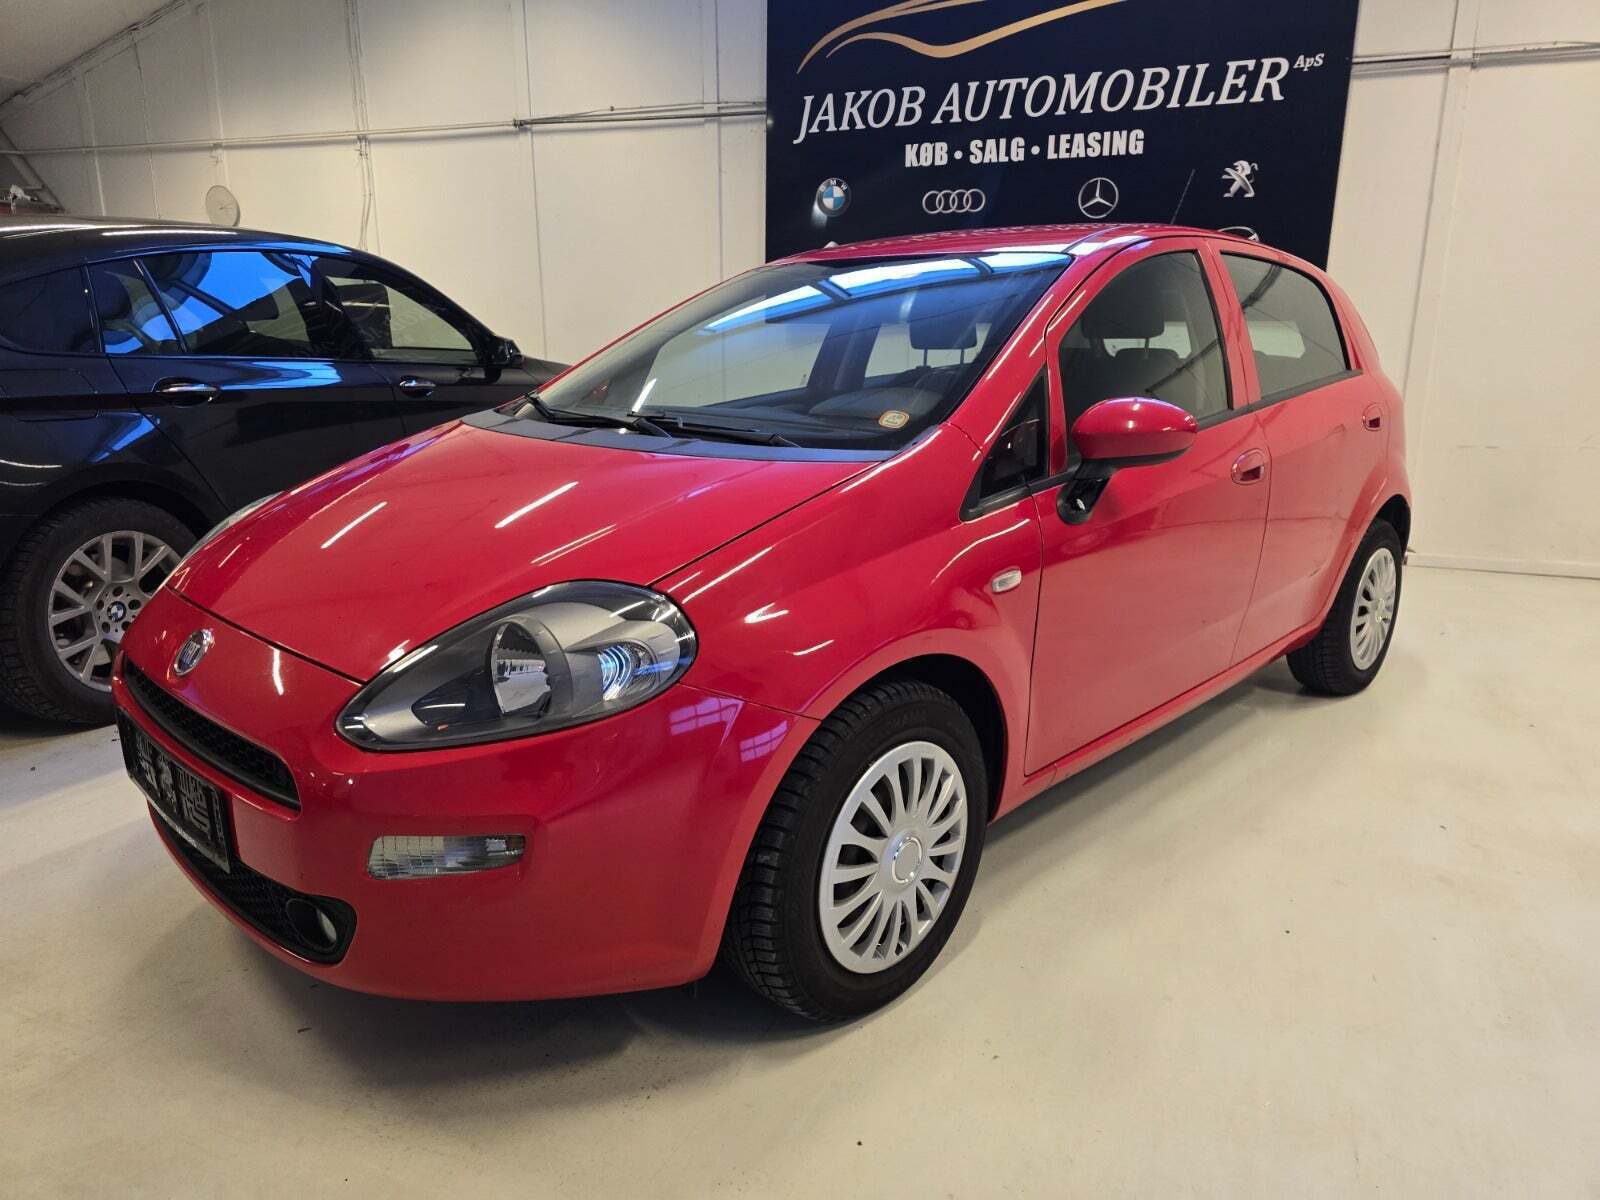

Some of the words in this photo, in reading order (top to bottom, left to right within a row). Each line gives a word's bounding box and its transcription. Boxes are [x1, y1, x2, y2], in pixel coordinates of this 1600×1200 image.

[793, 85, 926, 144] JAKOB
[931, 57, 1290, 124] AUTOMOBILER
[1293, 53, 1325, 71] ApS
[904, 142, 948, 168] KØB
[969, 137, 1025, 164] SALG
[1047, 129, 1145, 159] LEASING
